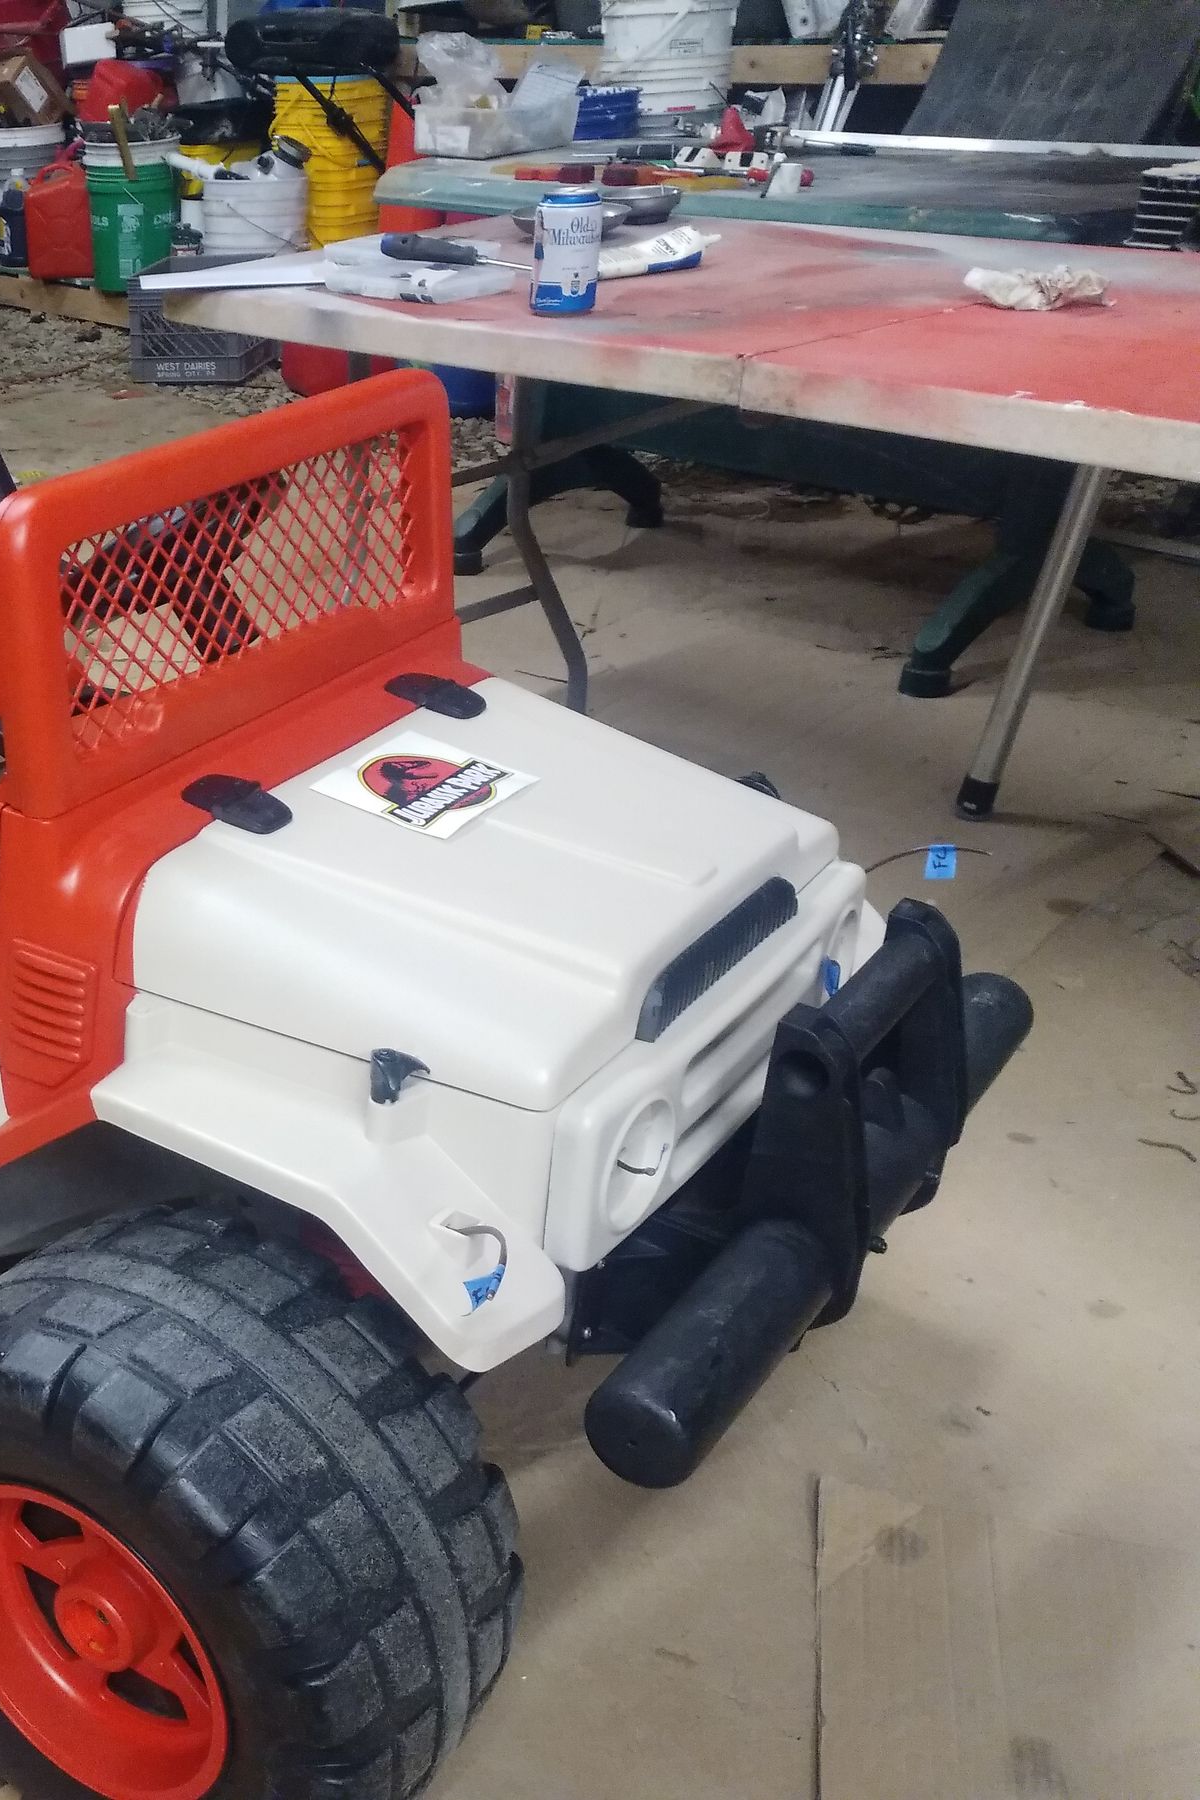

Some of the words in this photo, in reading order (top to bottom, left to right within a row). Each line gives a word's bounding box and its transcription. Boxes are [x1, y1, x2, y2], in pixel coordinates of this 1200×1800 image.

[571, 216, 591, 233] Old
[156, 362, 180, 371] WEST
[183, 361, 217, 371] DAIRIES
[444, 762, 502, 791] PARK
